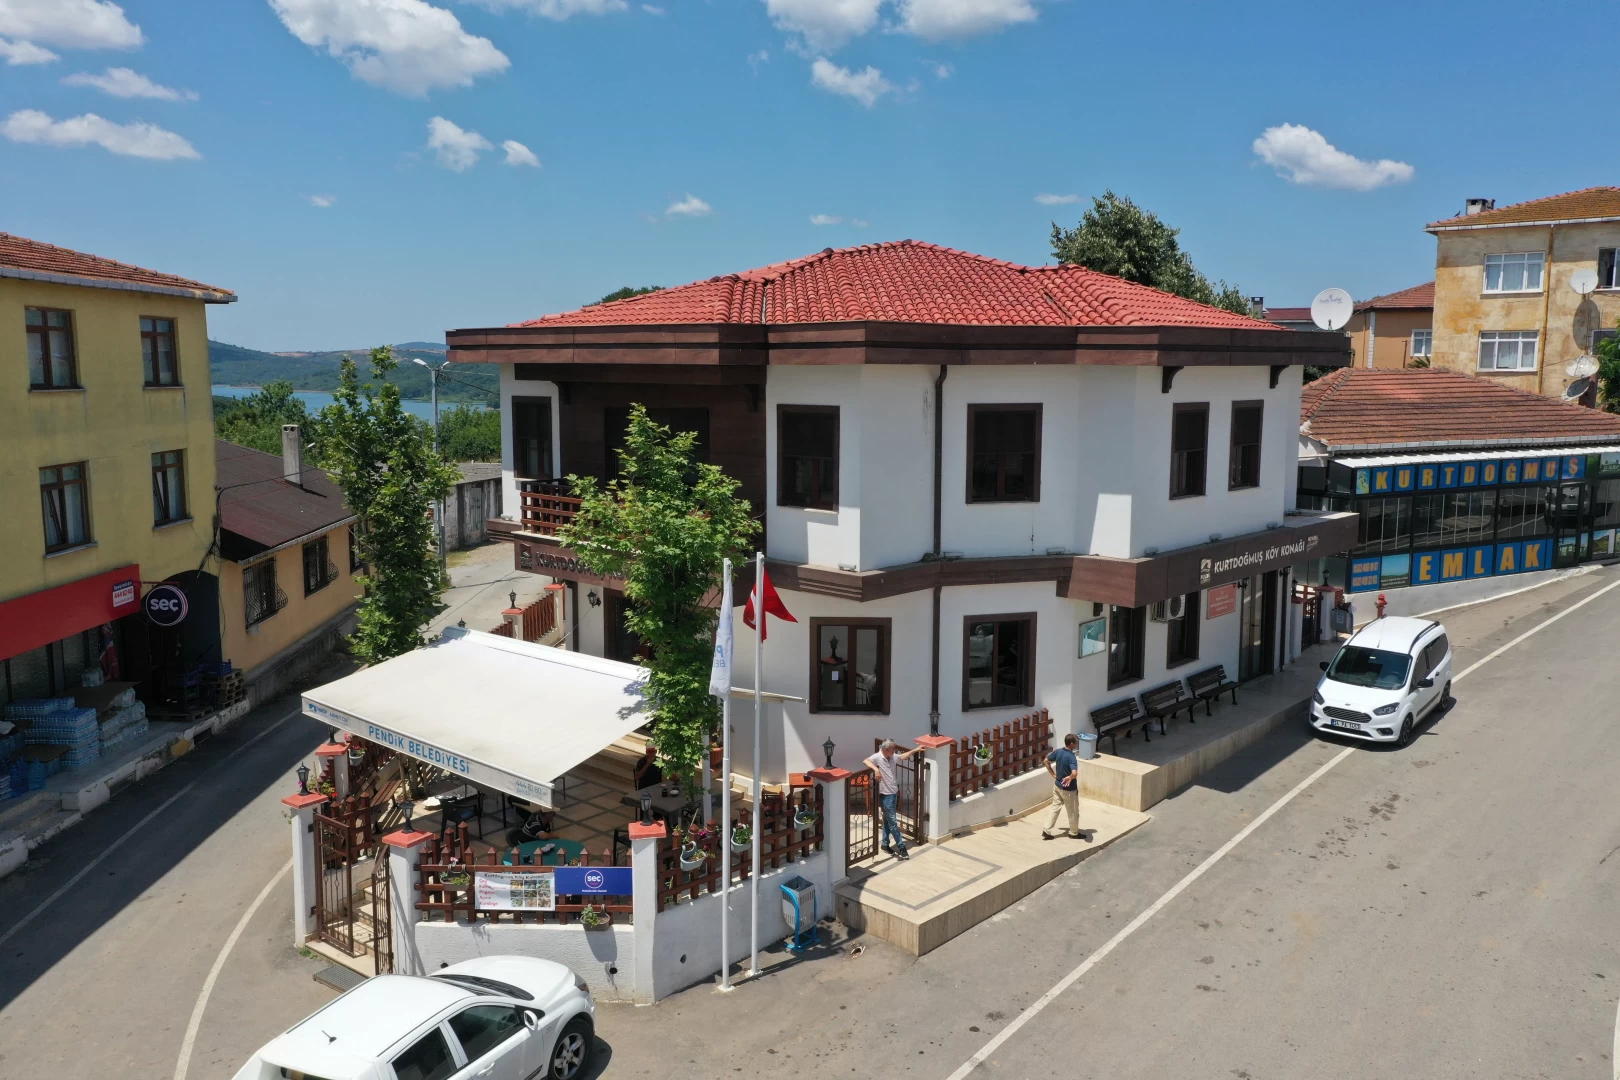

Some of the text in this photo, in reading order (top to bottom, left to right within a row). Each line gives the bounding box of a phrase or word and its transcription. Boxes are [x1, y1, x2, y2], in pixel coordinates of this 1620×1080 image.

[1375, 457, 1579, 490] KURTDOĞMUŞ
[1214, 551, 1263, 574] KURTDOĞMUŞ
[1265, 546, 1279, 561] KÖY
[1281, 539, 1305, 557] KONAĞI
[1419, 543, 1541, 582] EMLAK
[368, 725, 470, 774] PENDİK BELEDİYESİ
